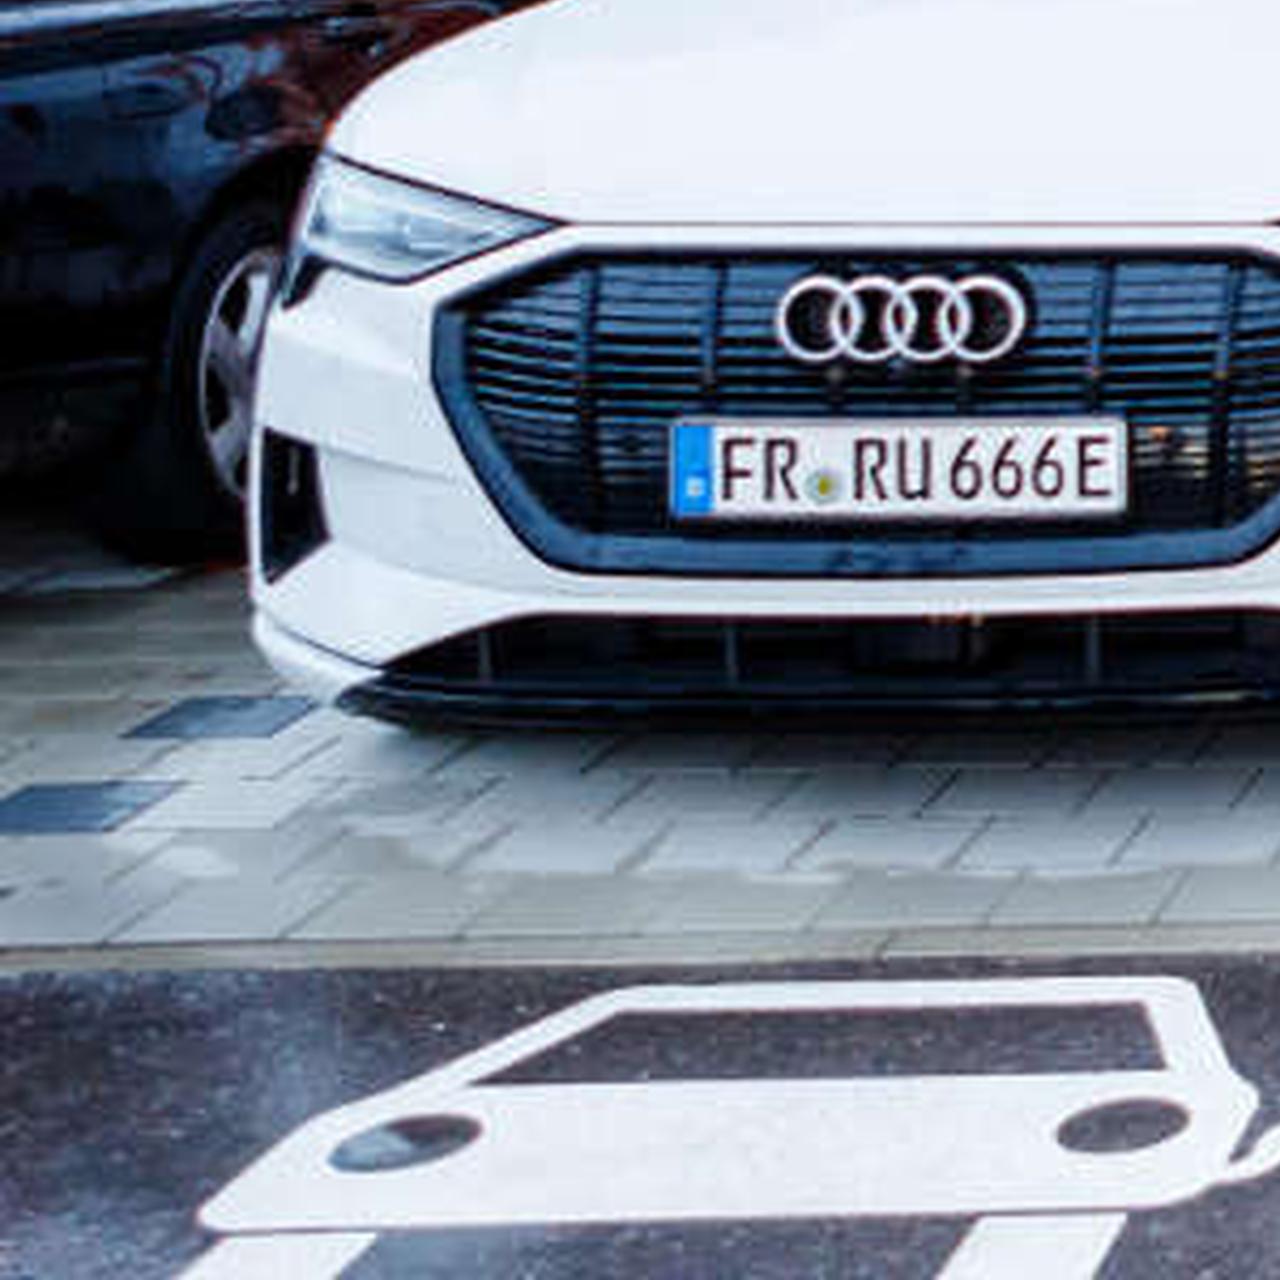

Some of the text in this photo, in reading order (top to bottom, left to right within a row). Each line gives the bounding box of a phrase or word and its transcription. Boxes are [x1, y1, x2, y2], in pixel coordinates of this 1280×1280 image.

[719, 436, 1113, 502] FR RU 666E
